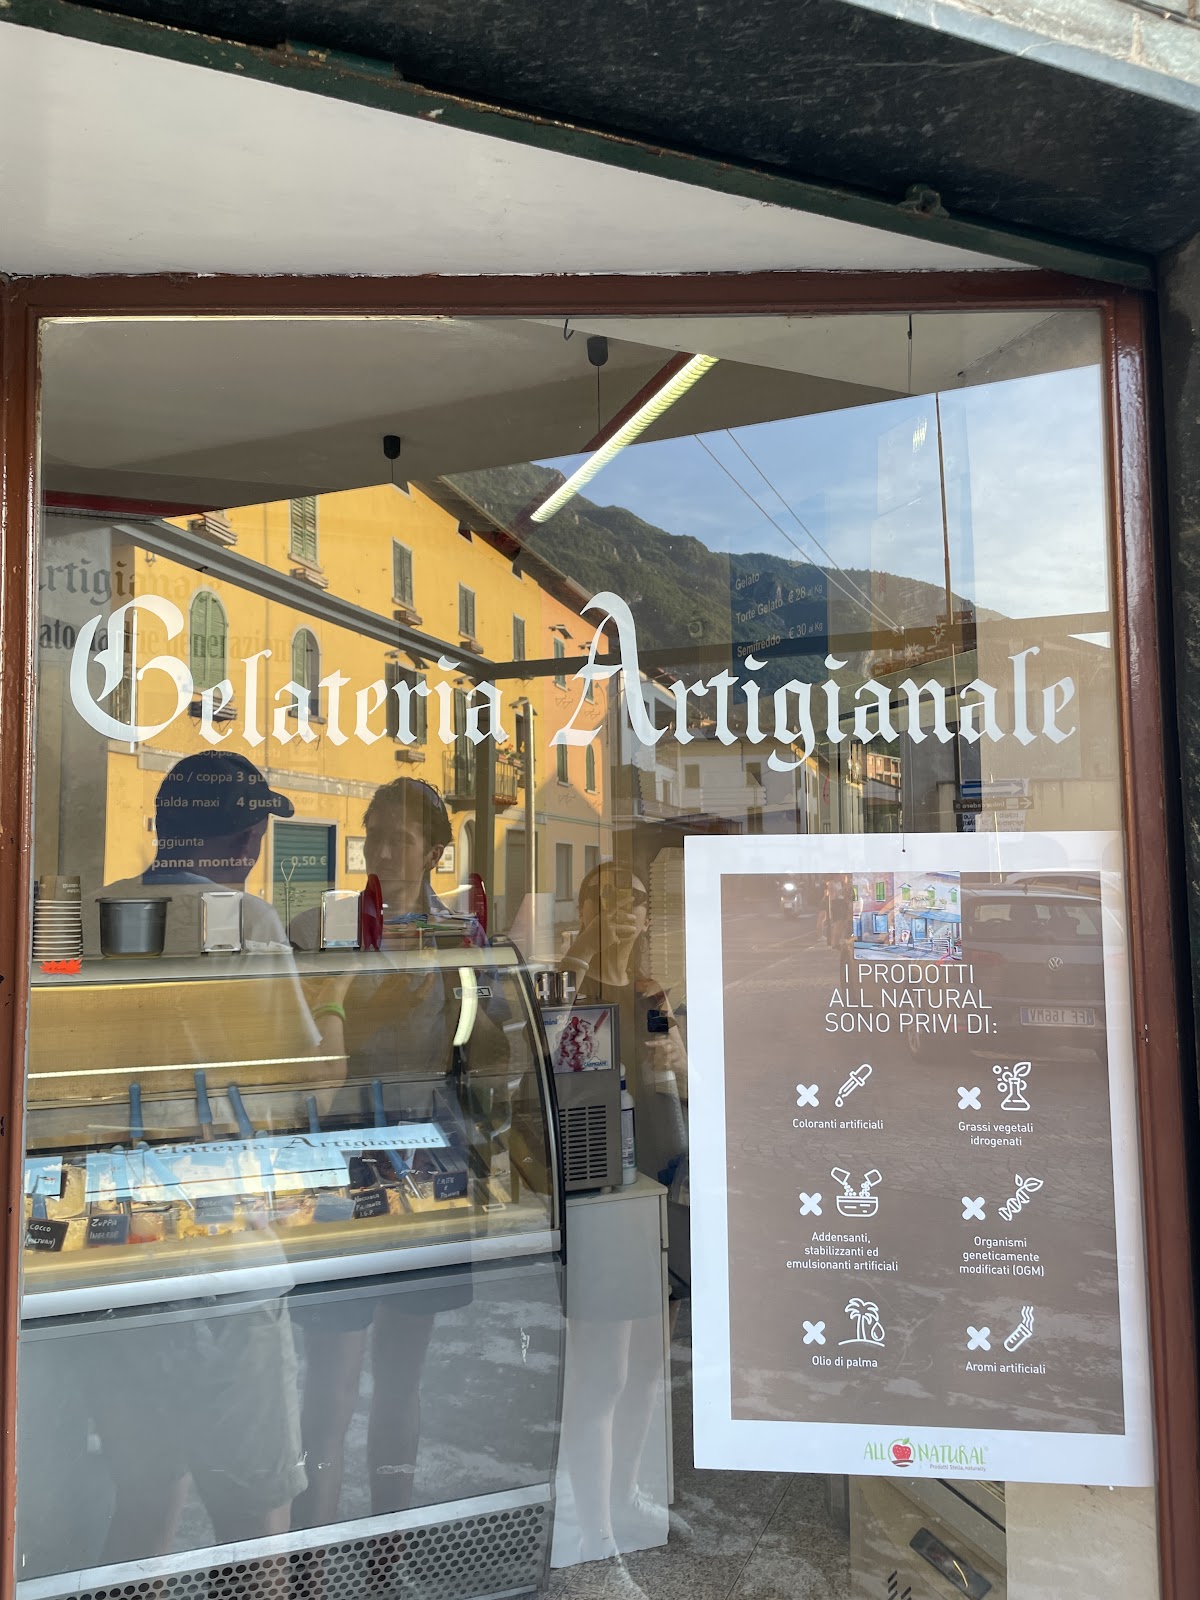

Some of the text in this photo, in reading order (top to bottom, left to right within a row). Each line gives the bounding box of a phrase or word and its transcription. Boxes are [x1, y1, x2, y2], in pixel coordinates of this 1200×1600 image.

[735, 572, 760, 590] Gelato
[736, 609, 756, 624] Torte
[757, 598, 783, 616] Gelato
[788, 590, 794, 603] €
[795, 586, 806, 601] 28
[814, 584, 823, 594] Kg
[737, 621, 823, 657] Semifreddo € 30 al Kg
[70, 591, 1076, 772] Gelateria Artigianale
[196, 773, 233, 786] coppa
[237, 771, 245, 783] 3
[153, 796, 189, 808] Cialda
[192, 797, 220, 808] maxi
[236, 797, 246, 808] 4
[249, 796, 282, 811] gusti
[152, 837, 205, 850] aggiunta
[151, 855, 328, 871] panna montata 0,50 €
[845, 963, 974, 984] I PRODOTTI
[829, 988, 992, 1009] ALL NATURAL
[825, 1012, 998, 1034] SONO PRIVI DI:
[792, 1118, 884, 1130] Coloranti artificiali
[958, 1121, 1034, 1135] Grassi vegetali
[970, 1135, 1022, 1148] idrogenati
[812, 1231, 871, 1244] Addensanti,
[974, 1236, 1027, 1249] Organismi
[804, 1246, 879, 1257] stabilizzanti ed
[963, 1250, 1040, 1263] geneticamente
[786, 1260, 898, 1272] emulsionanti artificiali
[959, 1264, 1045, 1278] modificati (OGM)
[812, 1355, 878, 1369] Olio di palma
[965, 1361, 1046, 1374] Aromi artificiali
[864, 1441, 886, 1460] ALL
[964, 1465, 986, 1473] naturally
